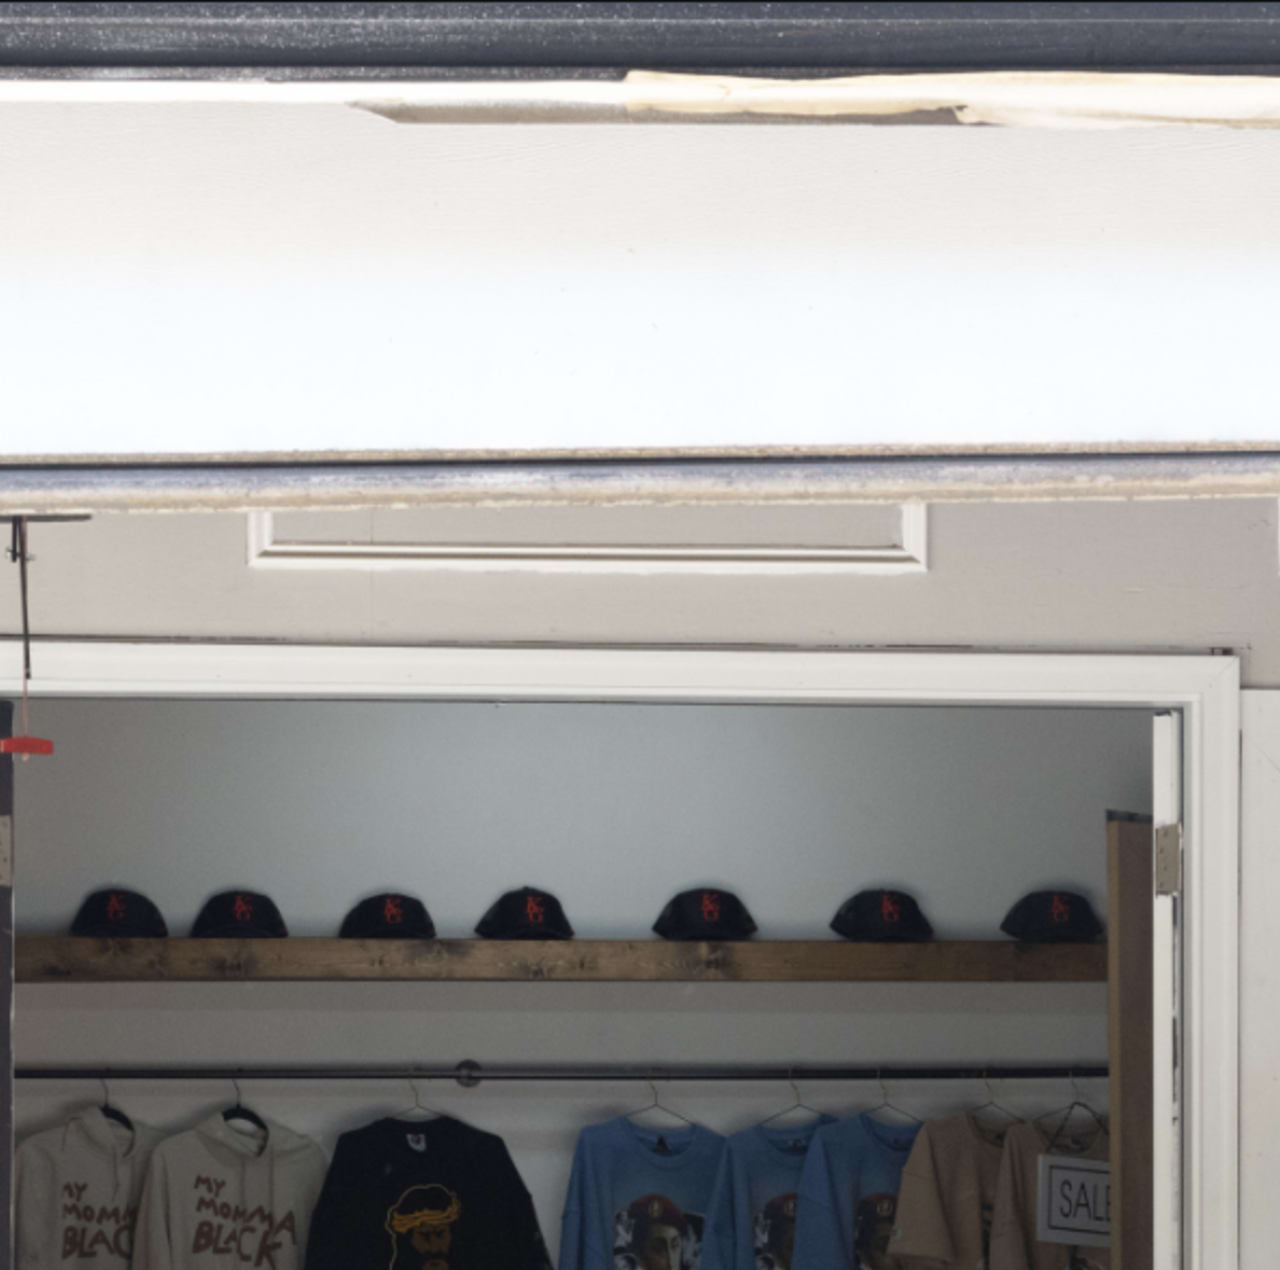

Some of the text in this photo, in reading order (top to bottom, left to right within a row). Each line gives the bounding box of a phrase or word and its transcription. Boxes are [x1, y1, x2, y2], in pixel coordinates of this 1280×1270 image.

[194, 1175, 226, 1198] MY
[196, 1197, 297, 1246] MOMMA
[62, 1225, 133, 1261] BLAC
